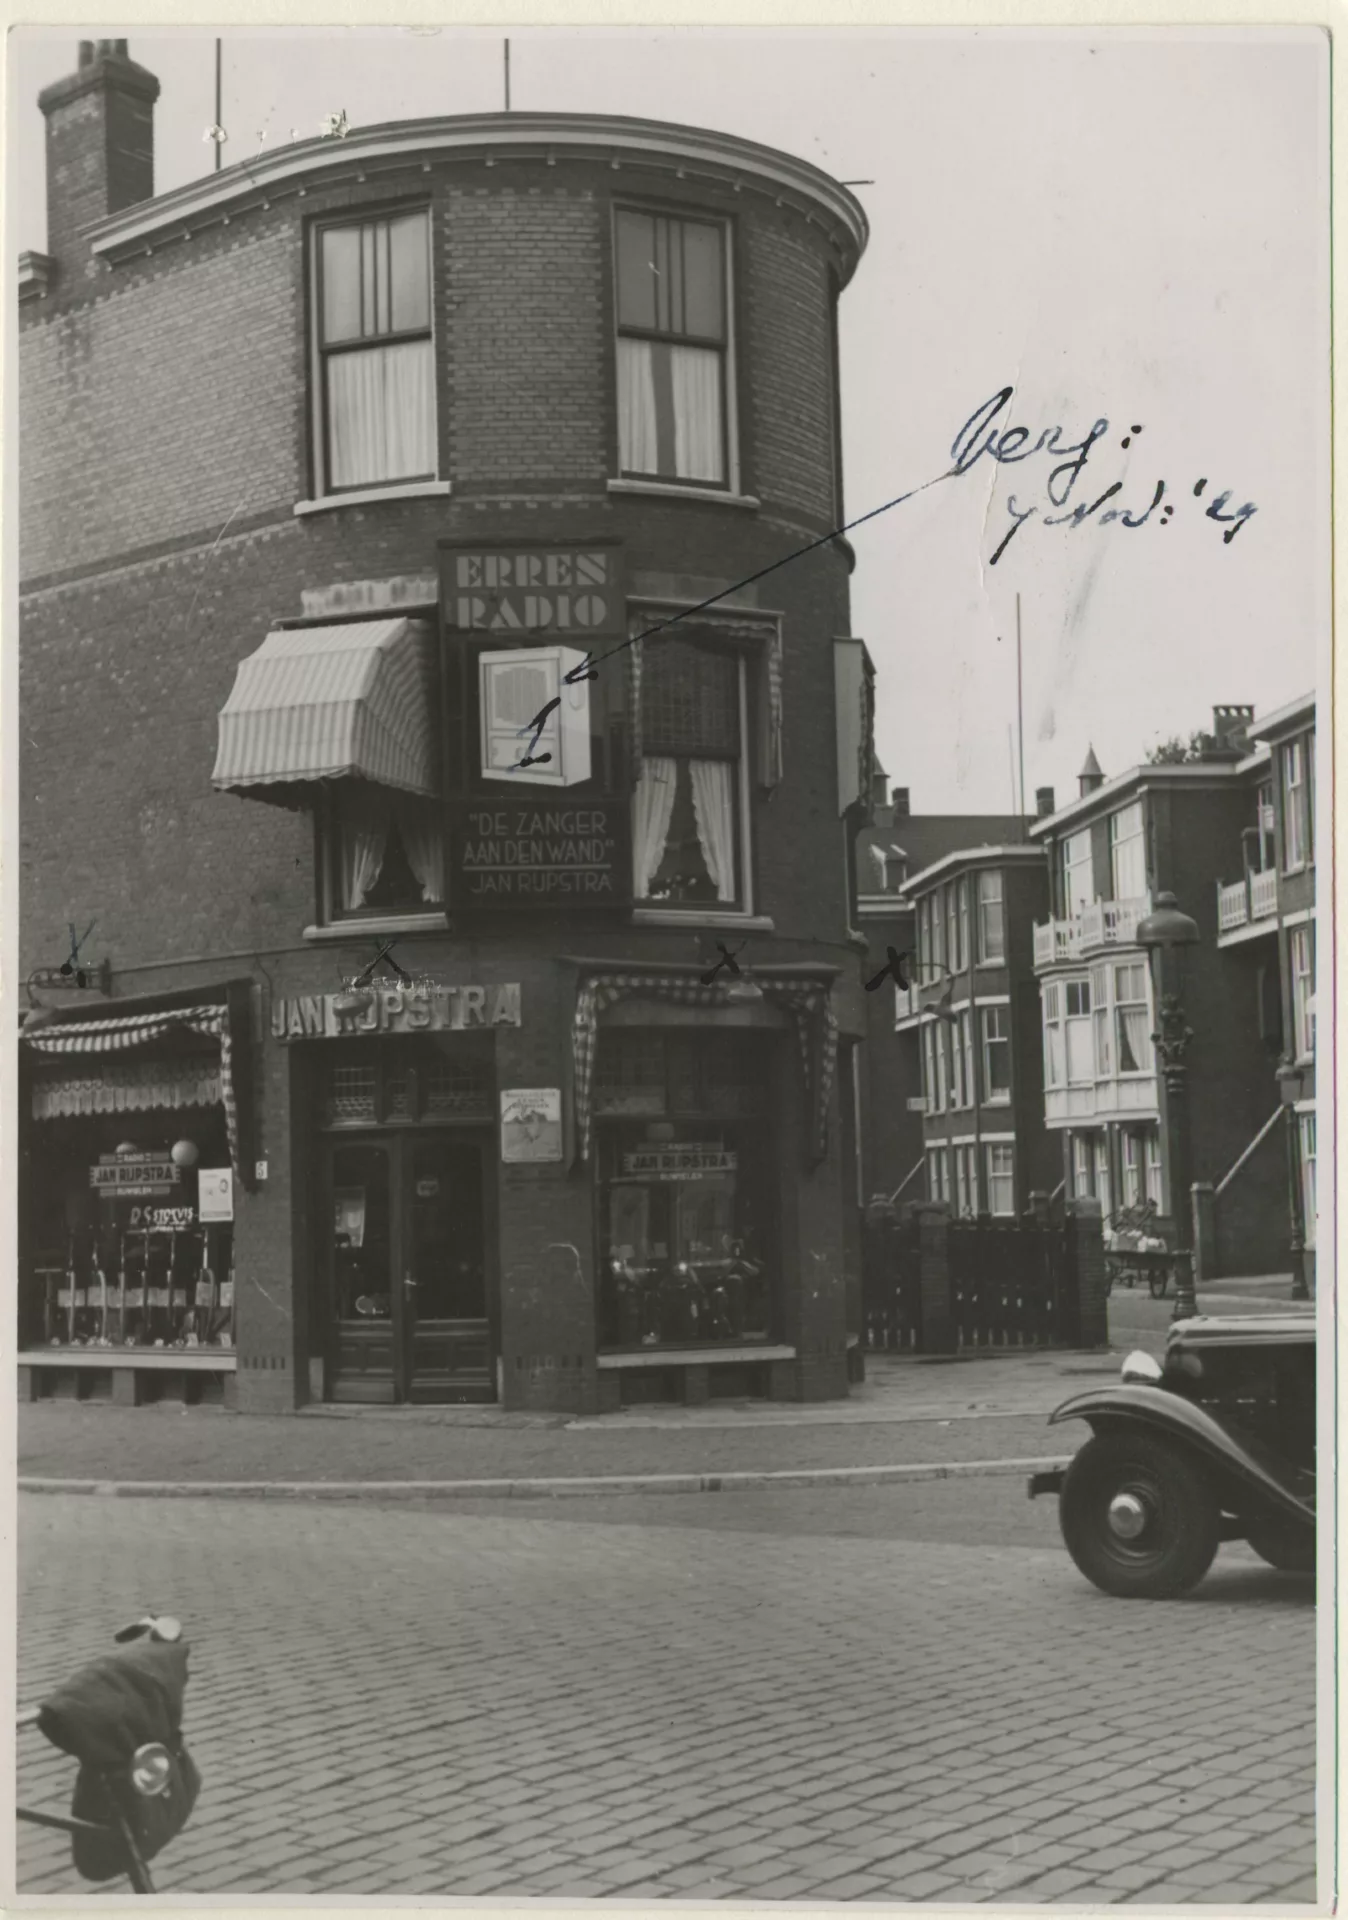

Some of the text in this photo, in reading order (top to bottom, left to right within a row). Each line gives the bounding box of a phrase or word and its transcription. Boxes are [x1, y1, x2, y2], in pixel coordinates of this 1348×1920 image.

[456, 554, 607, 588] ERRES
[457, 595, 607, 629] RADIO
[516, 811, 607, 836] ZANGER
[462, 840, 500, 865] AAN
[504, 839, 543, 864] DEN
[470, 872, 512, 893] JAN
[271, 995, 326, 1038] JAN
[96, 1168, 116, 1183] JAN
